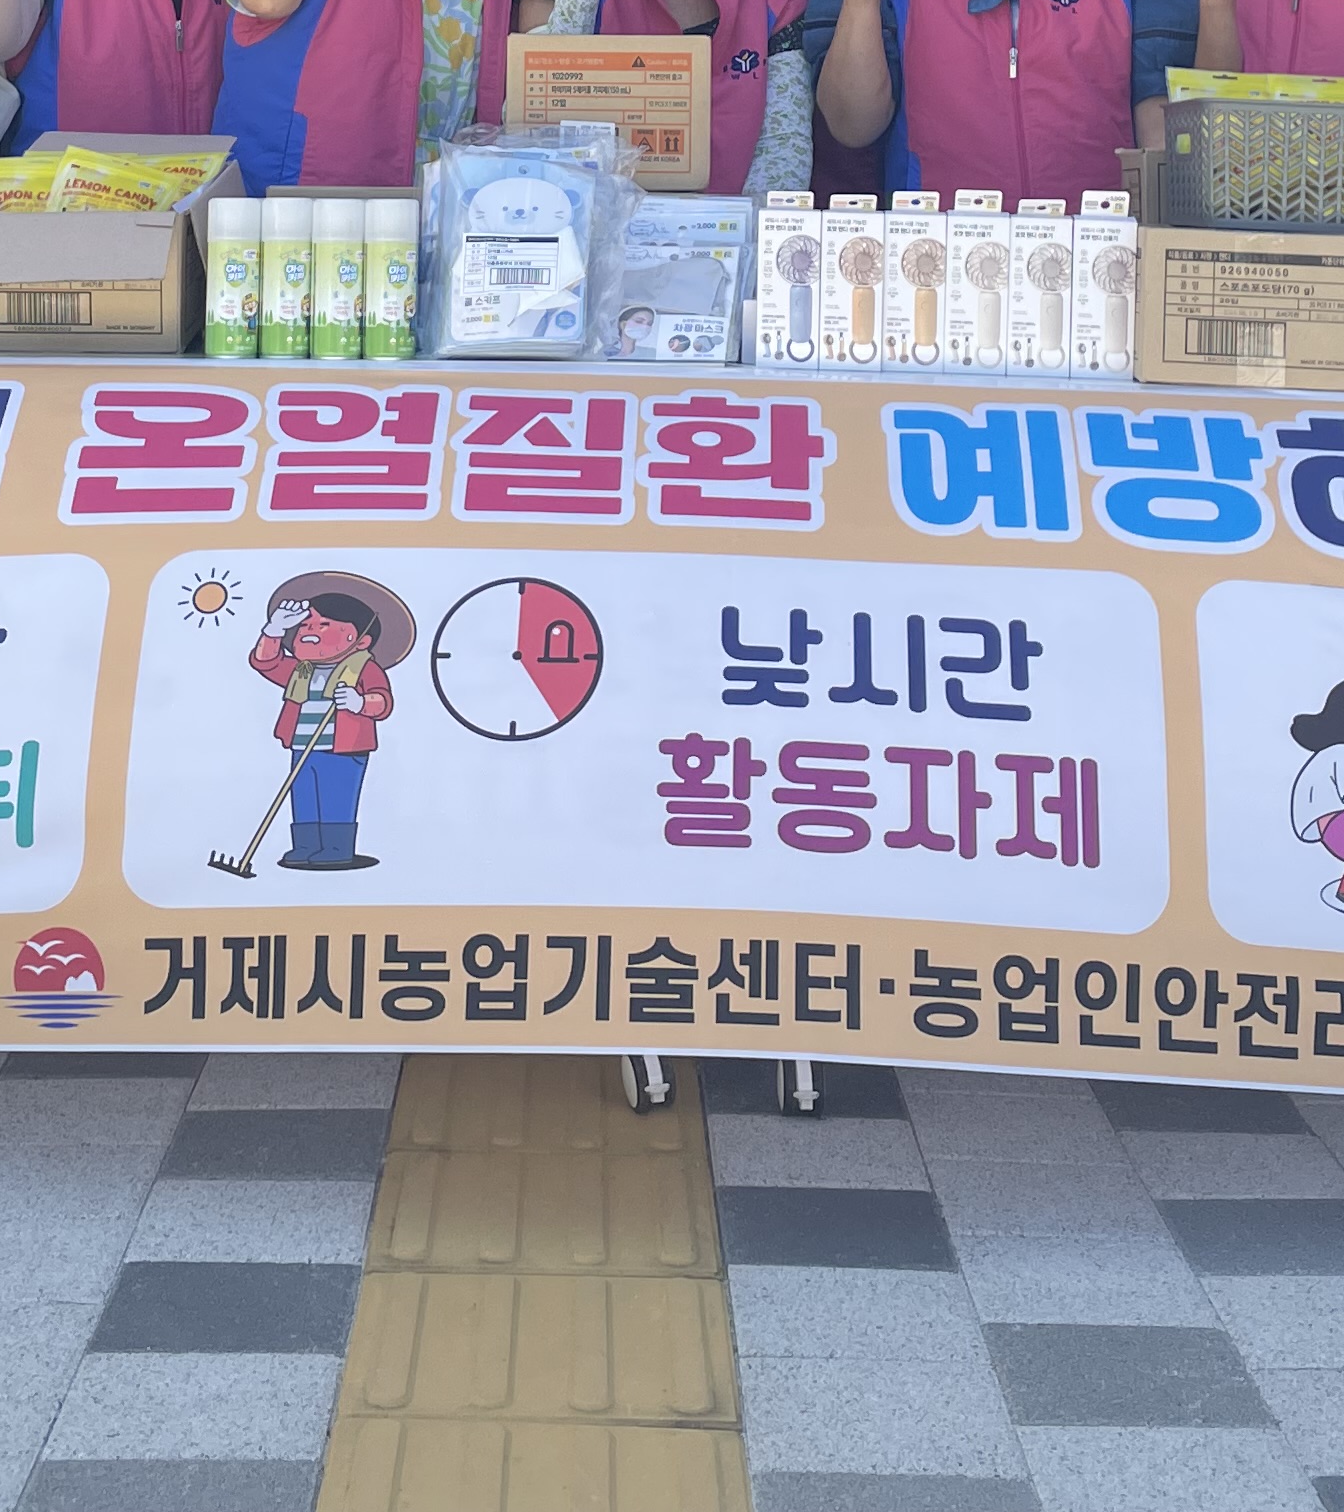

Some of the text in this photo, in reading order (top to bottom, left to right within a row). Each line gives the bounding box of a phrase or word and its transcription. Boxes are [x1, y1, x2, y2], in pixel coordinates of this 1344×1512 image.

[551, 72, 584, 81] 1020992
[163, 166, 207, 178] CANDY
[64, 178, 159, 210] LEMON CANDY
[1220, 265, 1290, 278] 926940050
[1303, 284, 1316, 297] g)
[475, 295, 501, 306] 스카프
[694, 323, 724, 334] 마스크
[66, 387, 826, 522] 온열질환
[719, 604, 1045, 722] 낮시간
[656, 732, 1102, 869] 활동자제
